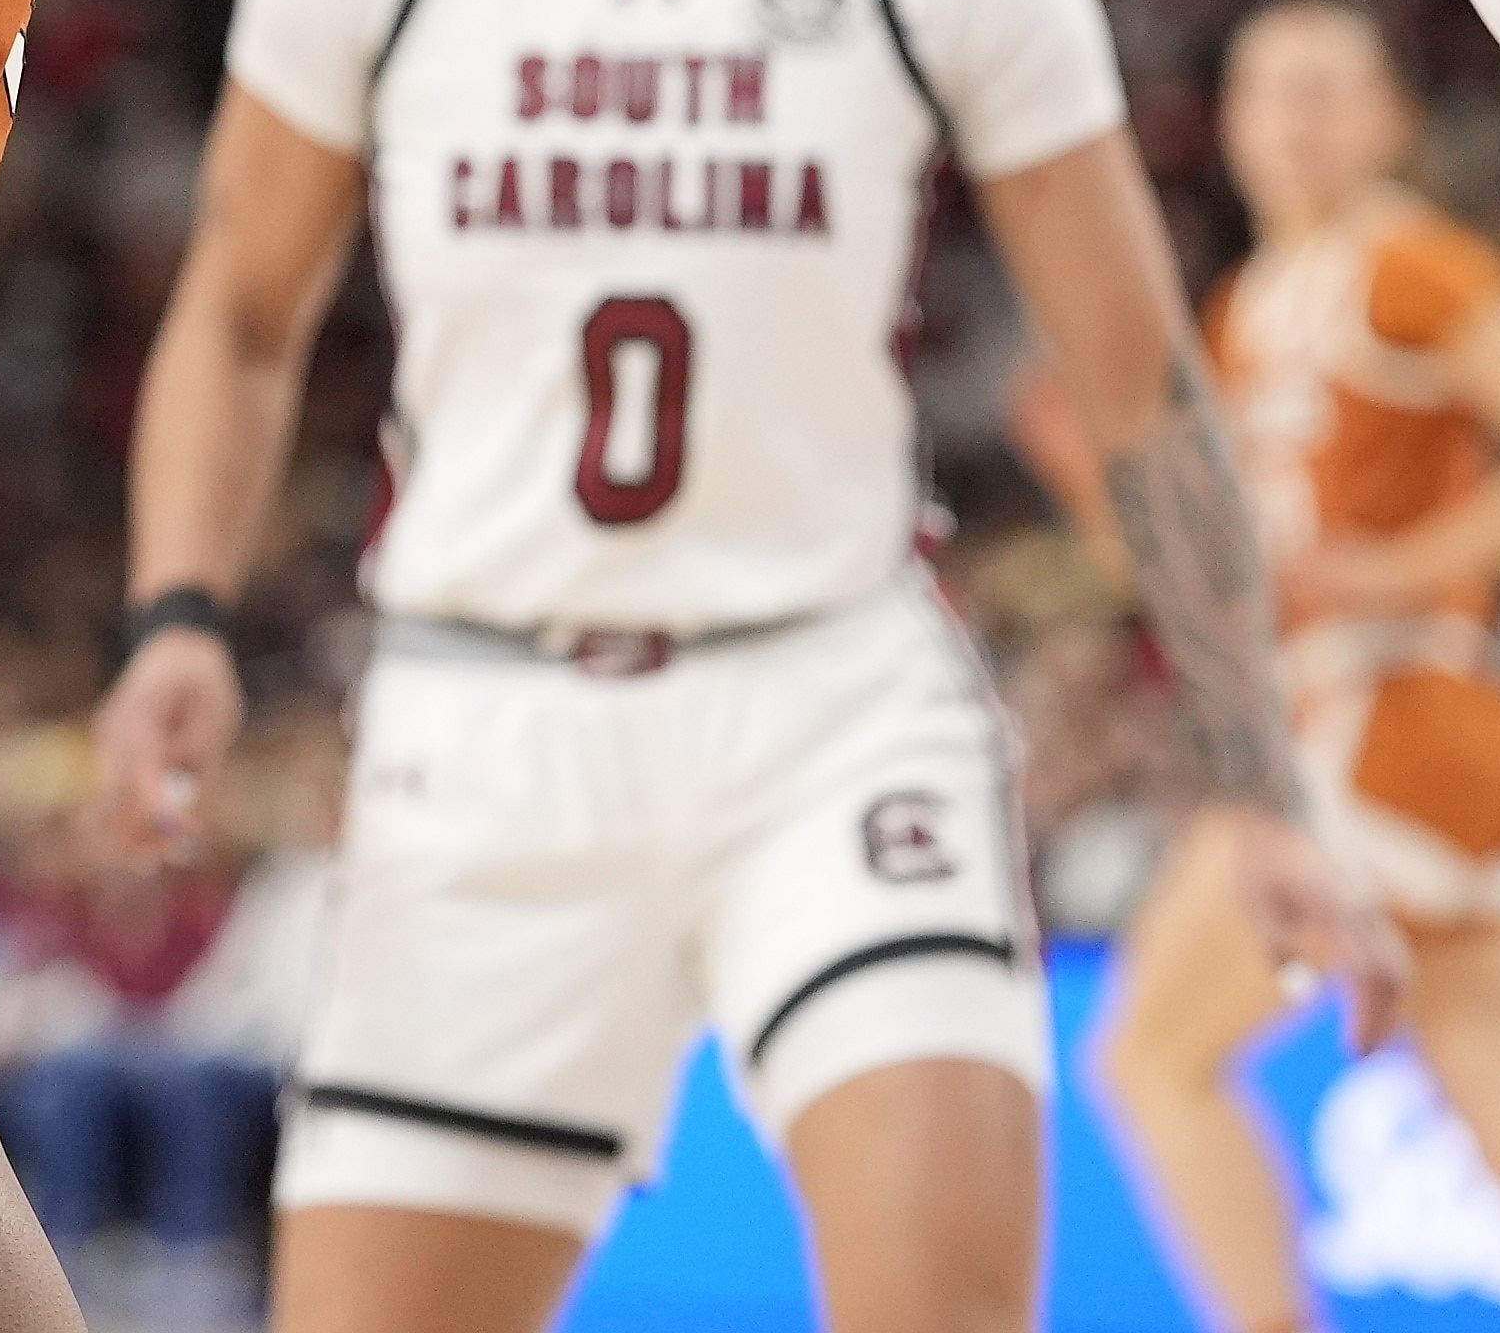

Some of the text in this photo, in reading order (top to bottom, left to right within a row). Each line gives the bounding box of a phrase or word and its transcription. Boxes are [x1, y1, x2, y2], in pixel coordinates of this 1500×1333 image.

[517, 53, 767, 123] SOUTH
[452, 158, 834, 233] CAROLINA
[575, 295, 692, 525] 0
